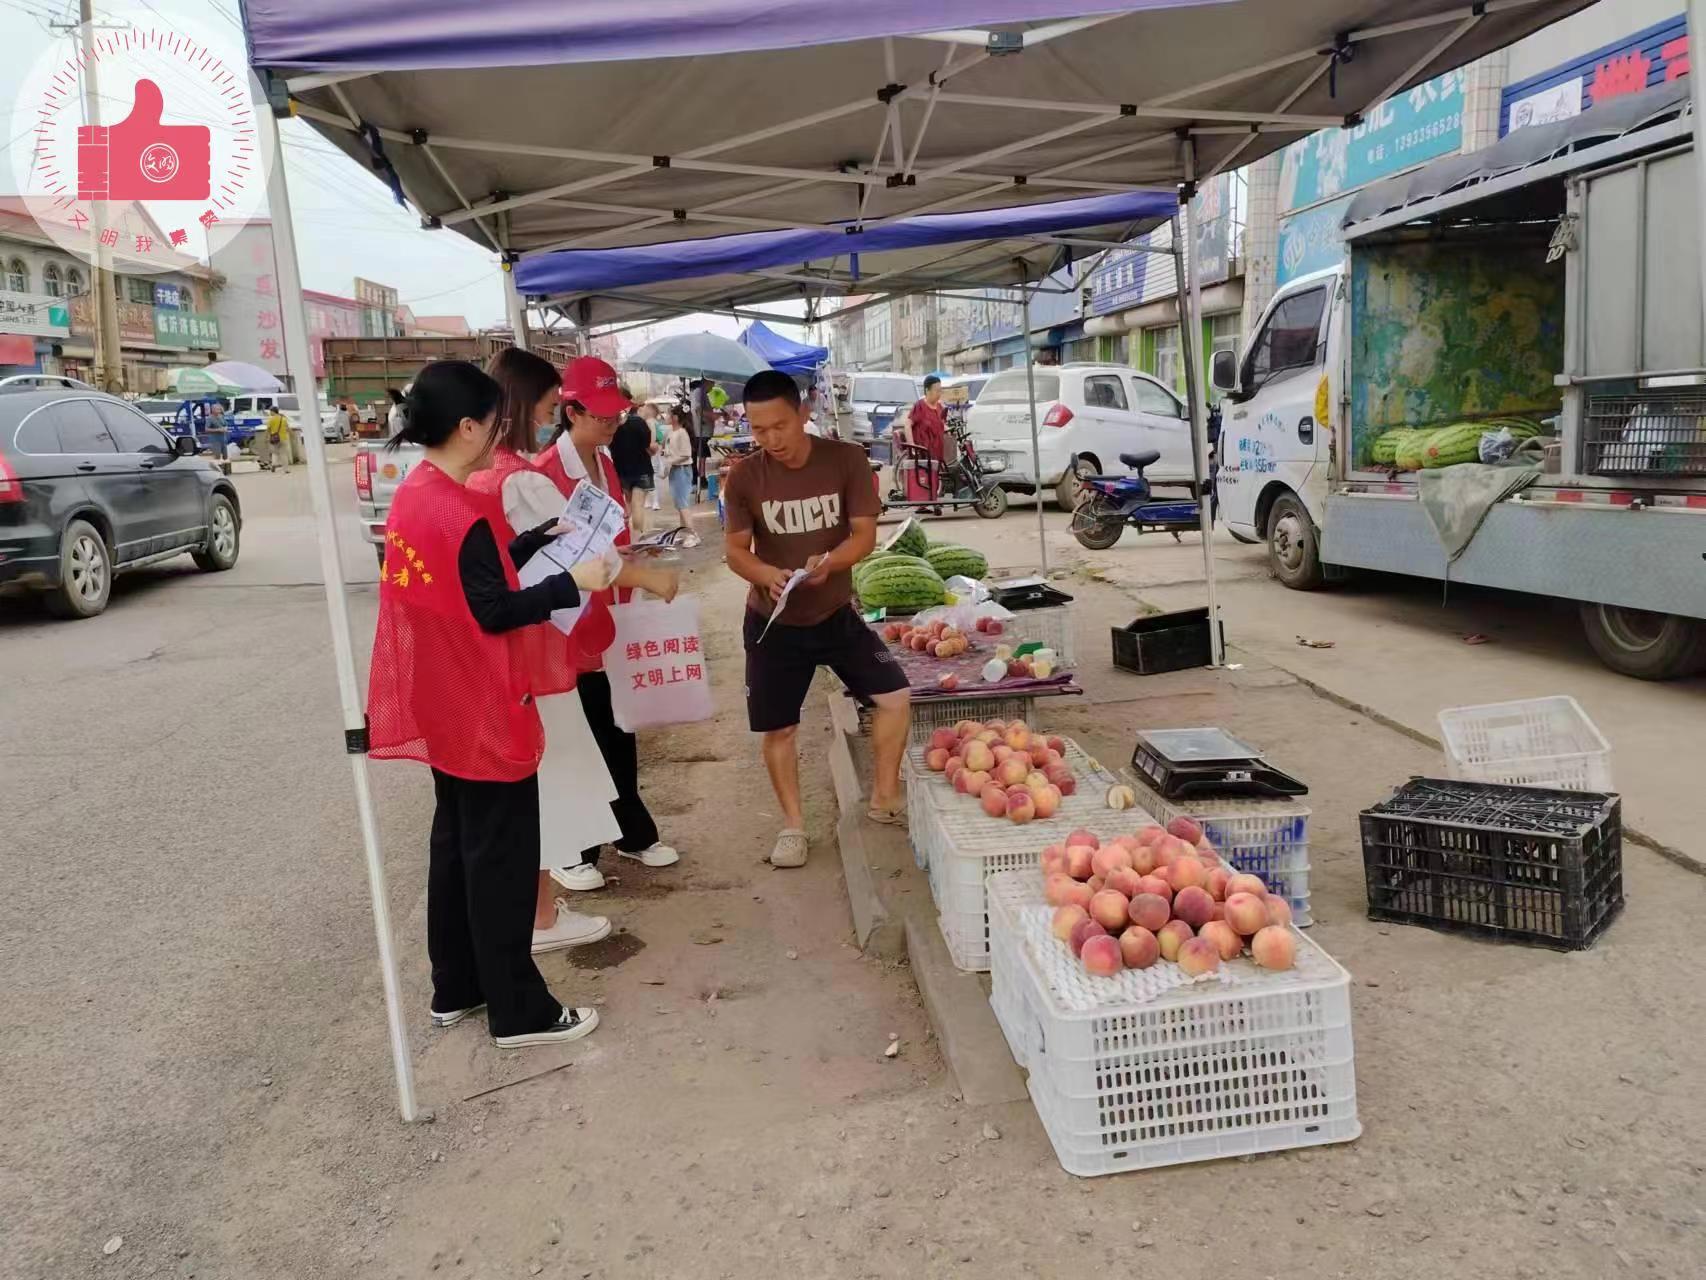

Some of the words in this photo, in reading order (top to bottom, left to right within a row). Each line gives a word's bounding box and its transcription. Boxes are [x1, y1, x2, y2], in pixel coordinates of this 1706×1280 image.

[626, 635, 699, 660] 绿色阅读
[631, 663, 702, 690] 文明上网
